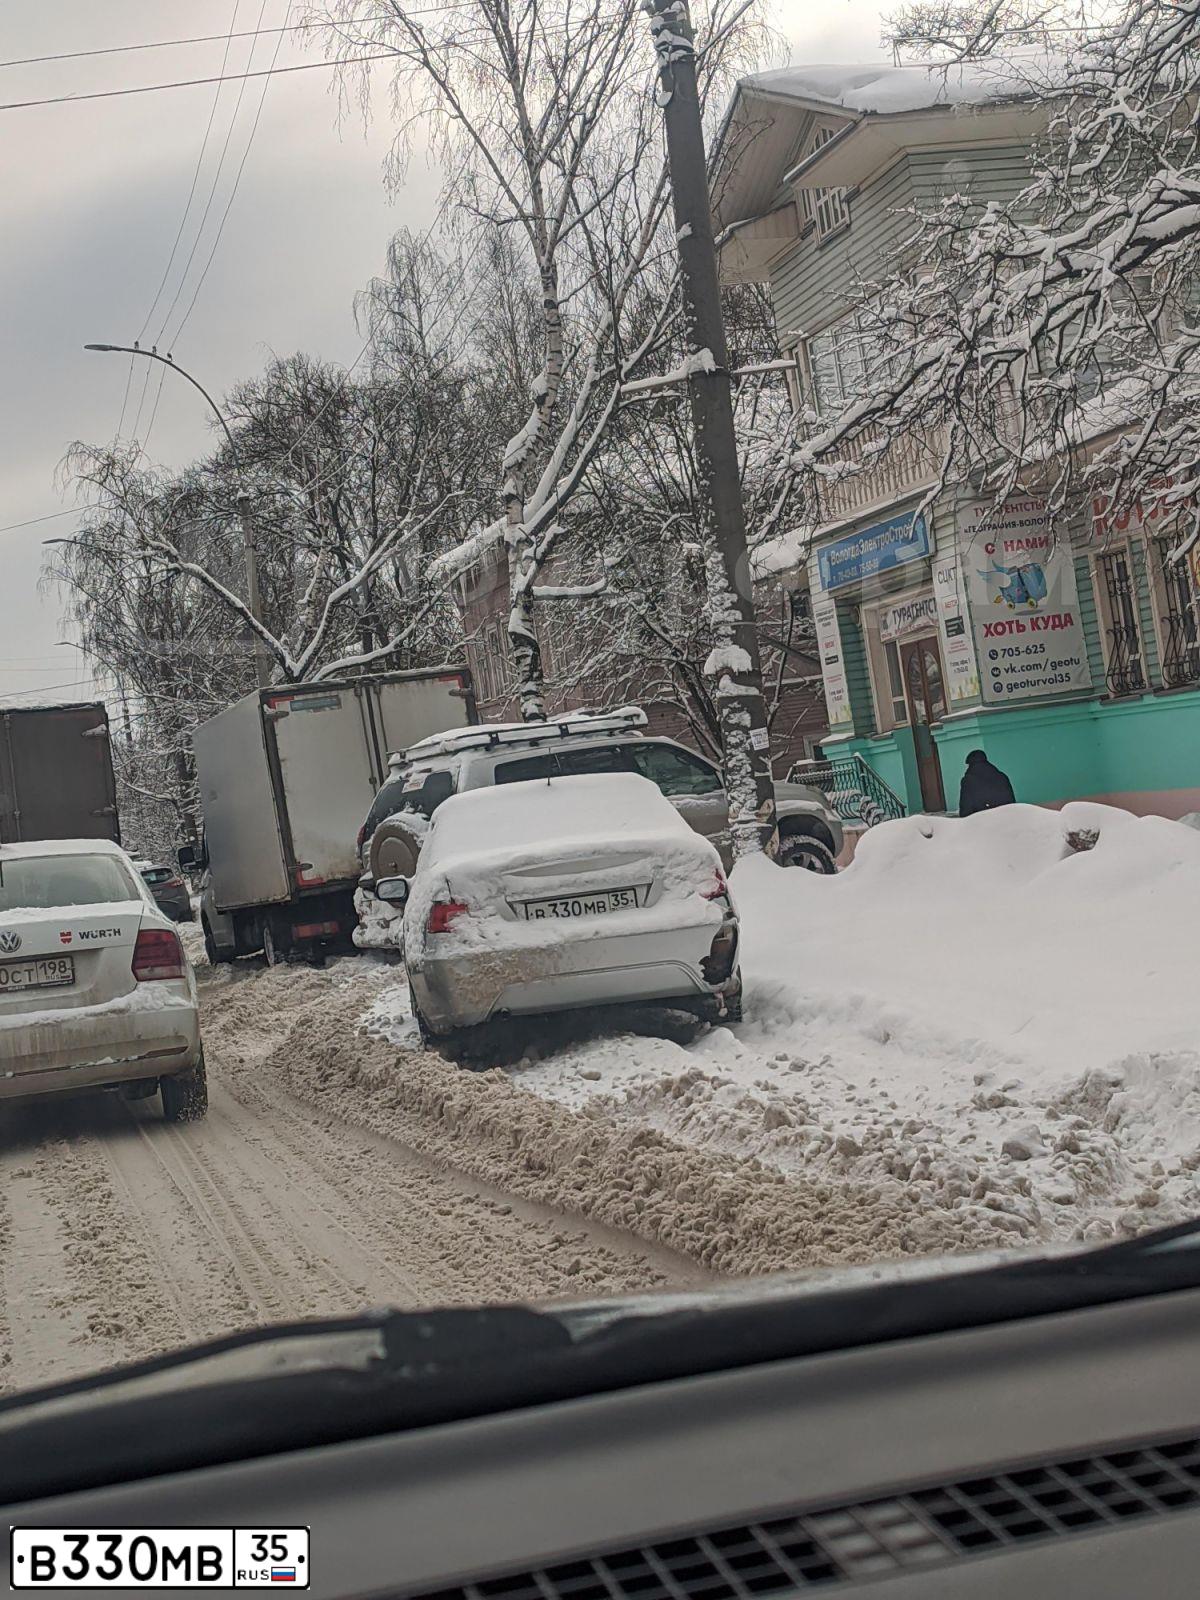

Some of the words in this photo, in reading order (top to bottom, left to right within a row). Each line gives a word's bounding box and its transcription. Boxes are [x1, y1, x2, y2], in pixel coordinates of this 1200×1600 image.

[1003, 536, 1049, 552] НАМИ
[983, 619, 1027, 638] ХОТЬ
[1030, 612, 1074, 631] КУДА
[1000, 643, 1046, 658] 705-625
[1003, 657, 1080, 672] vk.com/geotu
[1006, 673, 1071, 693] geoturvol35
[611, 892, 629, 907] 35
[39, 960, 67, 976] 198
